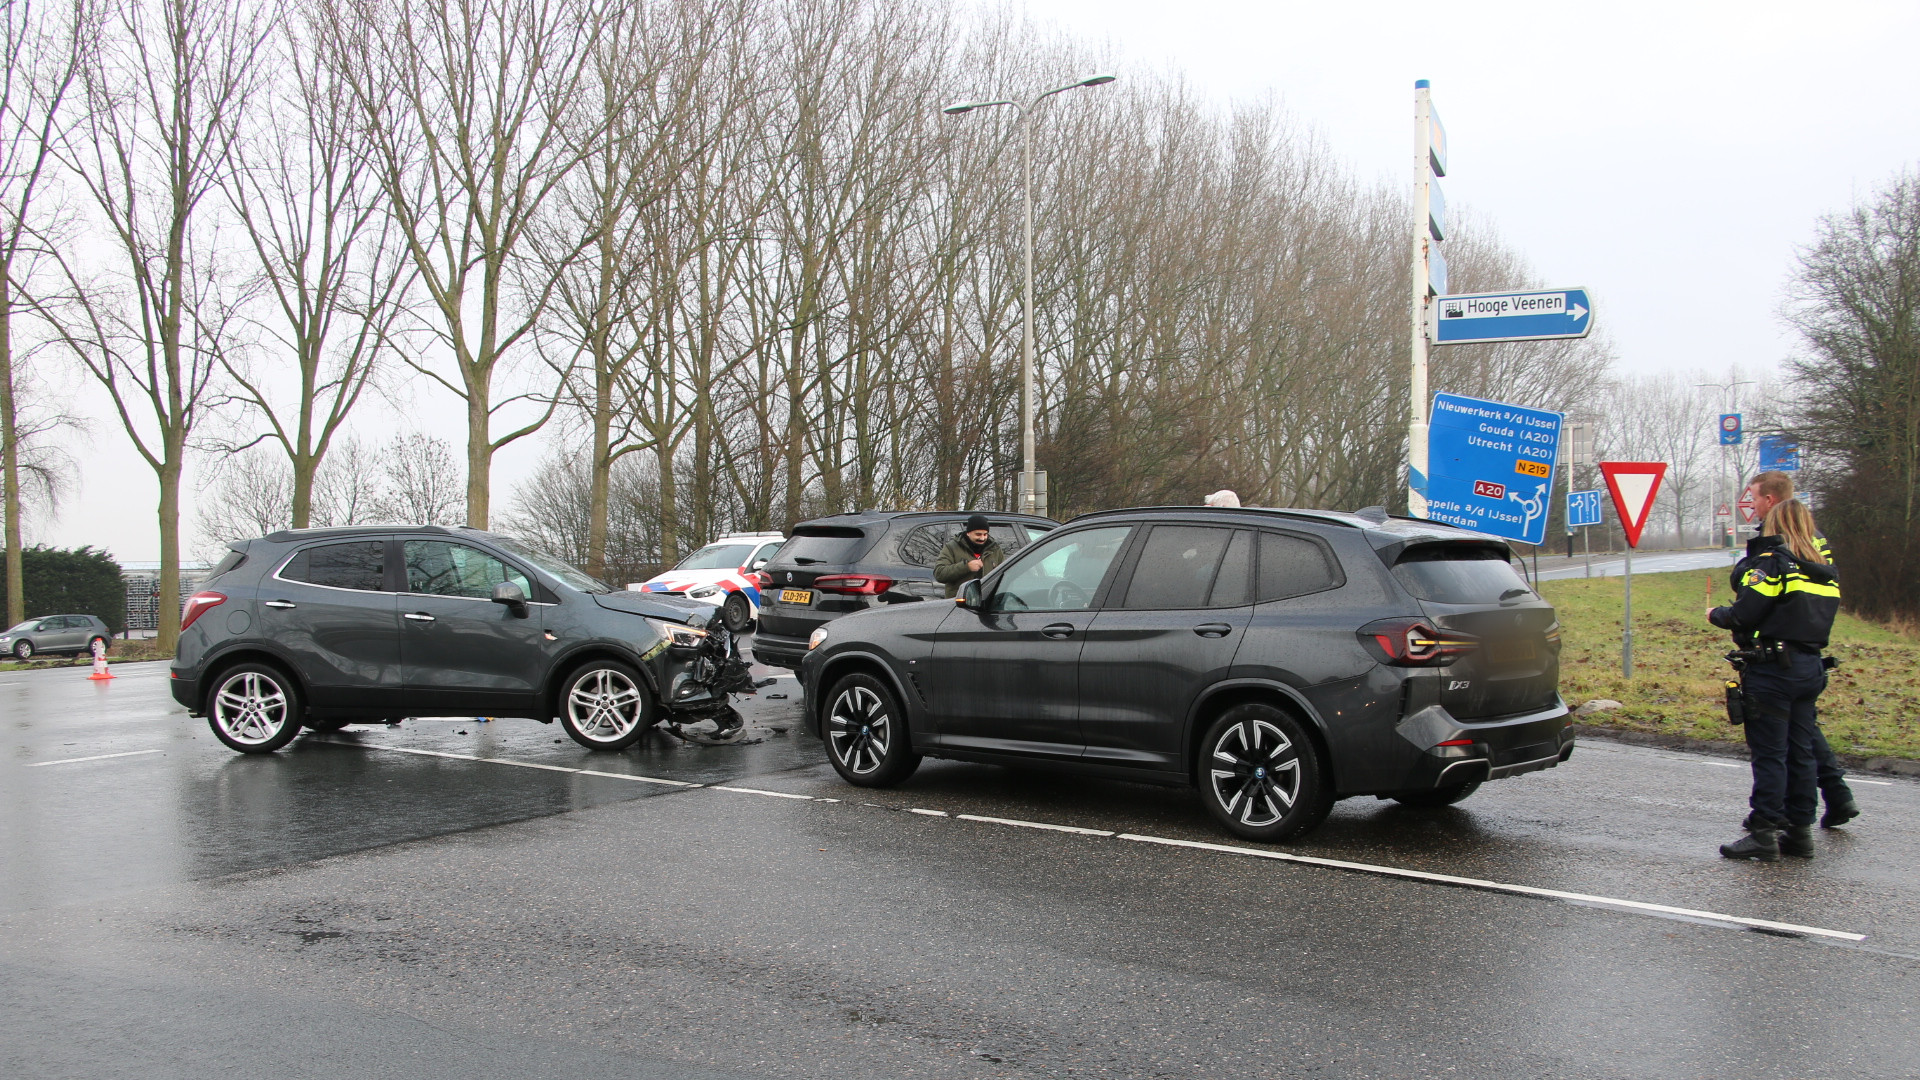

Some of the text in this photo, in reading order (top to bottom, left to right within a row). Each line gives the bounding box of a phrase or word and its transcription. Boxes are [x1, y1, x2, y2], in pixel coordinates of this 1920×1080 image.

[1467, 296, 1562, 316] Hooge Veenen
[1437, 400, 1557, 430] Nieuwerkerk a/d IJssel
[1479, 423, 1554, 444] Gouda (A20)
[1468, 435, 1552, 459] Utrecht (A20)
[1426, 511, 1478, 528] otterdam
[1427, 499, 1522, 524] apelle a/d IJssel
